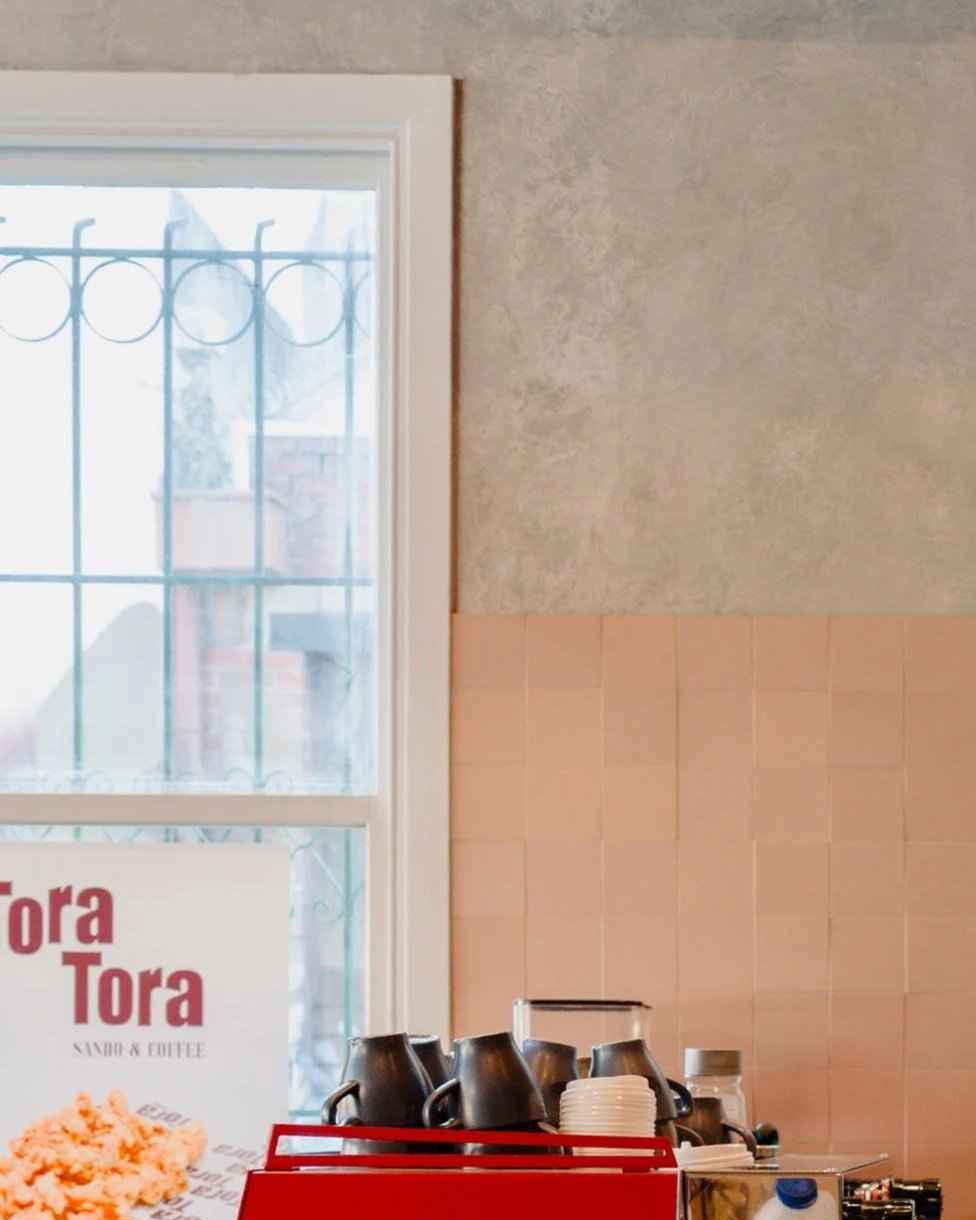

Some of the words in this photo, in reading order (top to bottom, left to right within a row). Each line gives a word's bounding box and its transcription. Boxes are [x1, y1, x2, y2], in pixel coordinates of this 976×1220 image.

[61, 951, 203, 1027] Tora
[73, 1042, 122, 1057] SANDO
[129, 1042, 140, 1056] &
[148, 1042, 206, 1058] COFFEE
